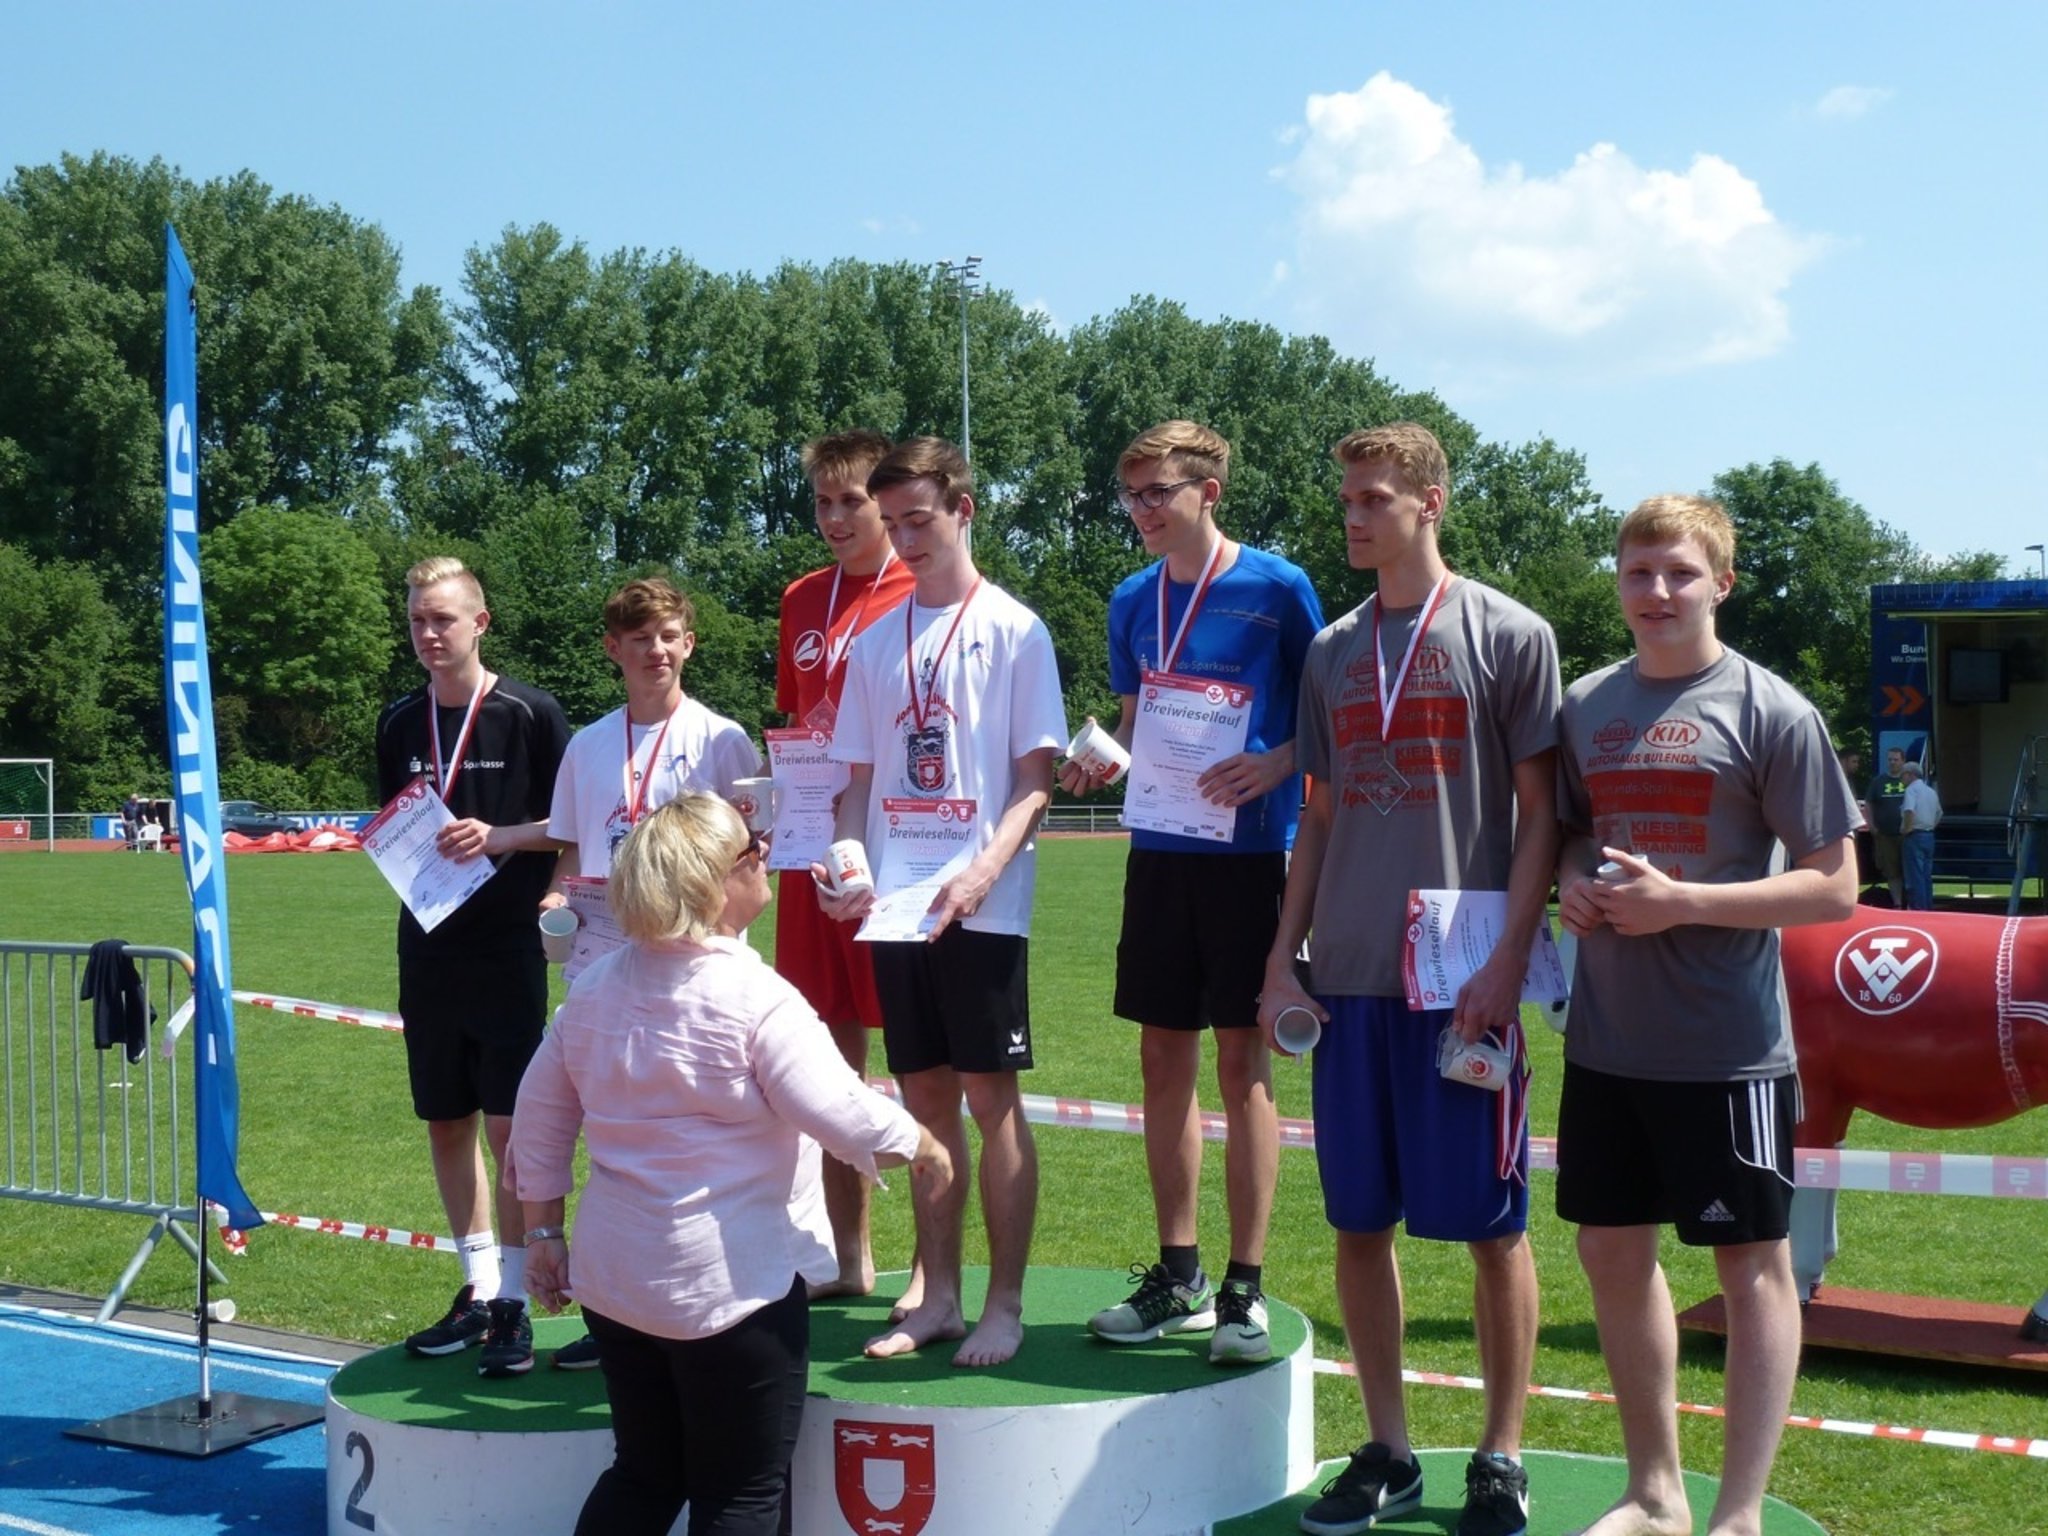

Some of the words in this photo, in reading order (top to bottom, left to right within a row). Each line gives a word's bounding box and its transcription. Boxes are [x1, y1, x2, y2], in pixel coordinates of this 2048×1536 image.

[1405, 680, 1451, 692] ULENDA
[1143, 701, 1242, 727] Dreiwiesellauf
[1652, 725, 1689, 743] KIA
[1587, 753, 1641, 768] AUTOHAUS
[1643, 752, 1698, 766] BULENDA
[374, 797, 436, 859] Dreiwiesellauf
[889, 826, 972, 842] Dreiwiesellauf
[1631, 821, 1706, 835] KIESER
[1632, 842, 1706, 854] TRAINING
[1429, 900, 1450, 1002] Dreiwiesellauf
[345, 1431, 375, 1532] 2
